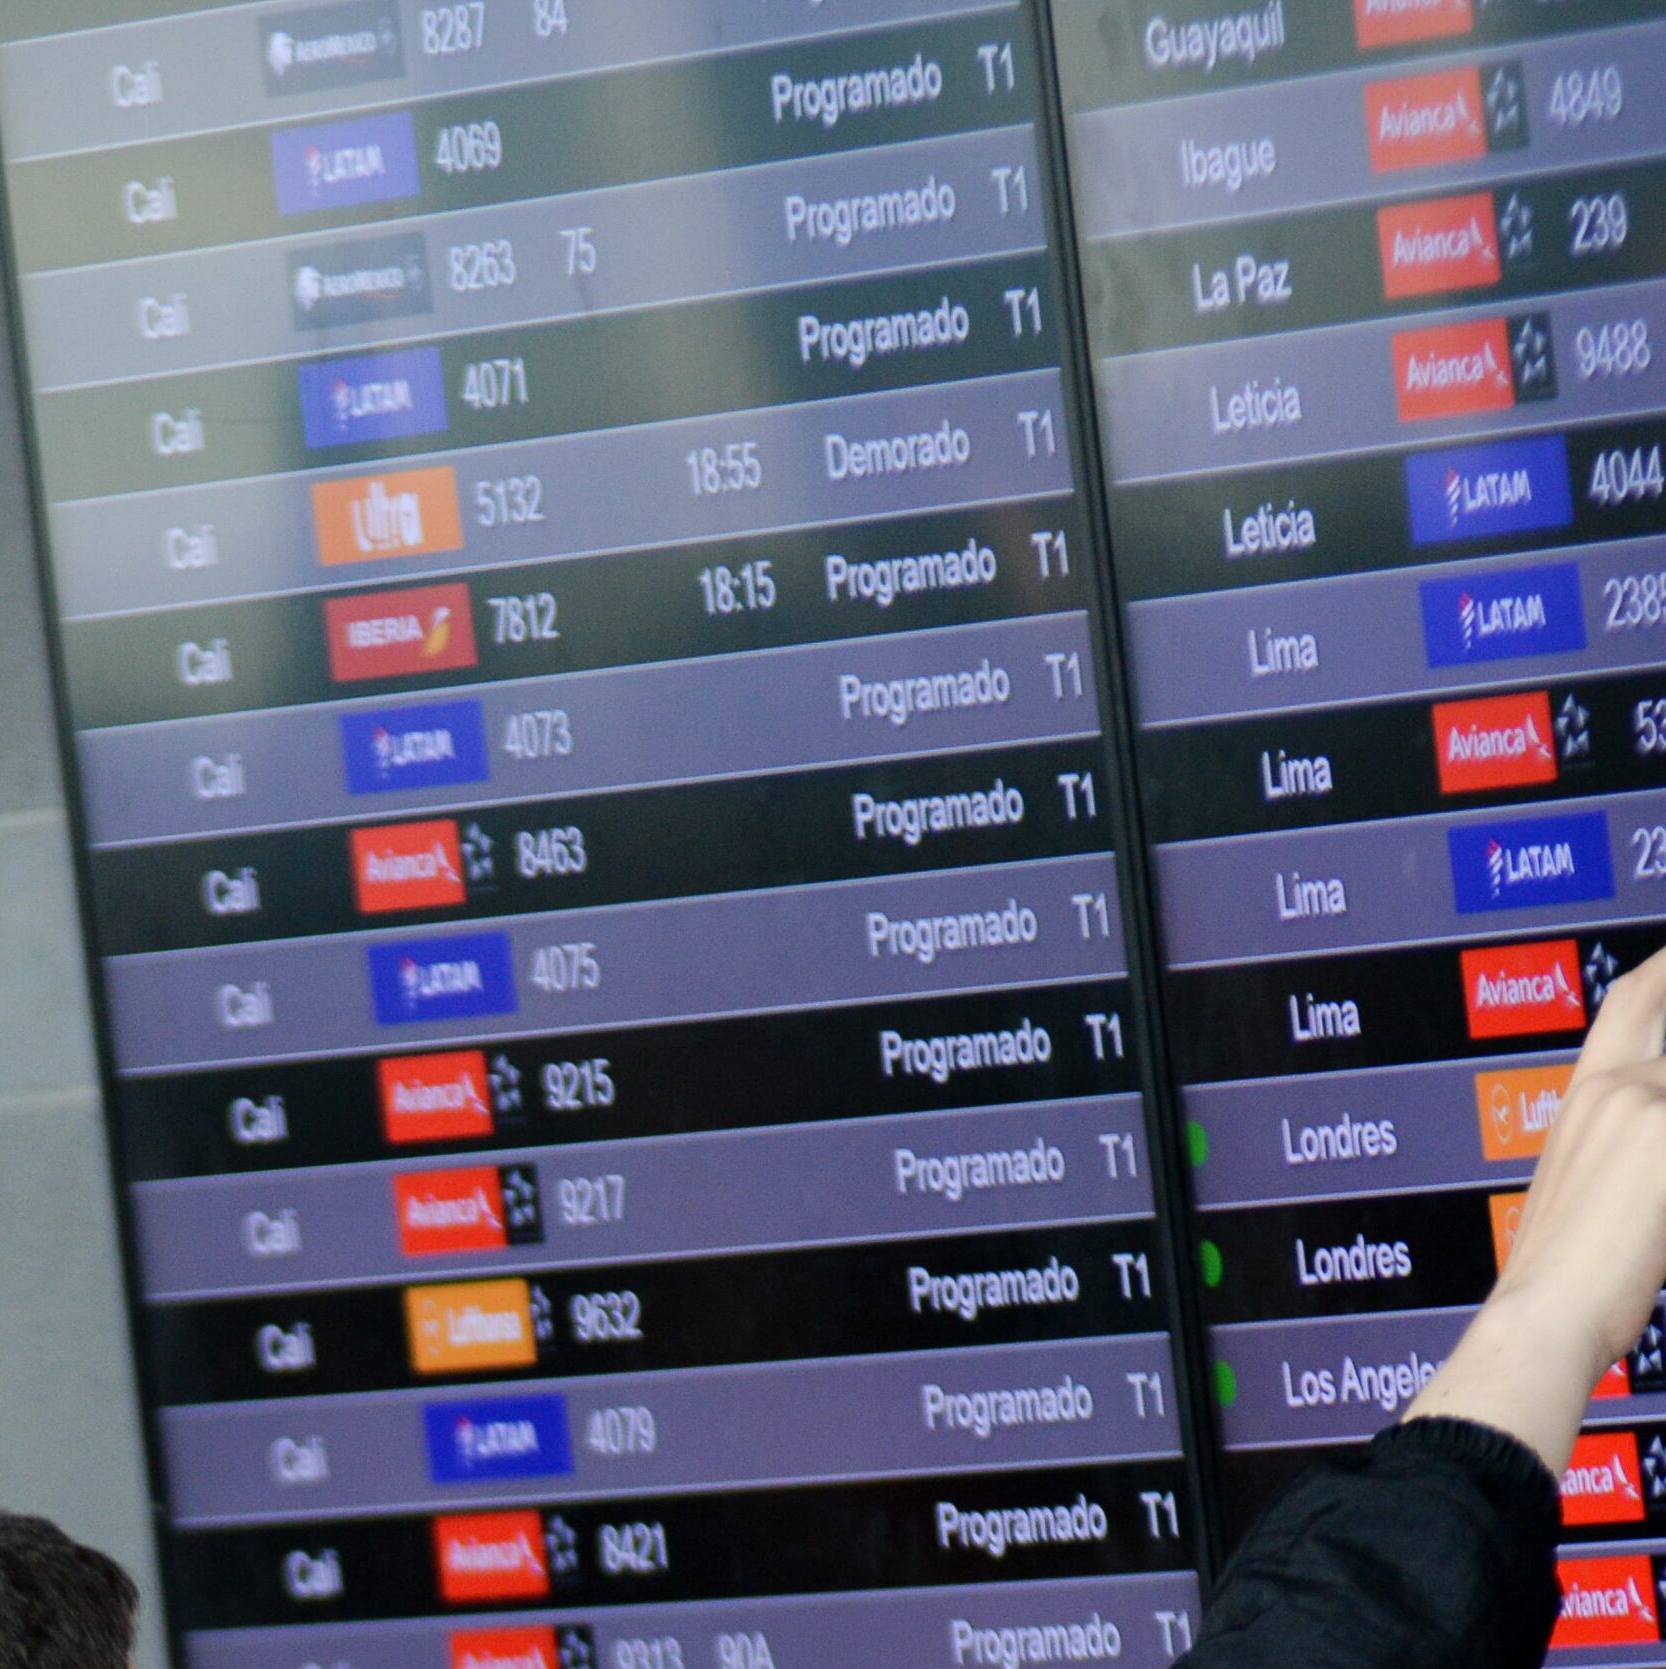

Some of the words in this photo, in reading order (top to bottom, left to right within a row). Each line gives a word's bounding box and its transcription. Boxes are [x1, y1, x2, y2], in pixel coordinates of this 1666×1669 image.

[110, 62, 162, 107] Cali
[421, 1, 485, 54] 8287
[1145, 8, 1286, 73] Guayaquil
[124, 177, 178, 224] Cali
[435, 121, 502, 173] 4069
[771, 53, 942, 127] Programado
[977, 42, 1015, 94] T1
[1180, 137, 1276, 190] Ibague
[1379, 91, 1456, 140] Avianca
[1549, 66, 1623, 127] 4849
[138, 293, 191, 340] Cali
[449, 240, 516, 292] 8263
[561, 227, 596, 275] 75
[785, 177, 956, 245] Programado
[991, 165, 1028, 213] T1
[1192, 262, 1229, 312] La
[1237, 255, 1293, 302] Paz
[1392, 228, 1470, 265] Avianca
[1570, 194, 1628, 257] 239
[152, 410, 205, 455] Cali
[463, 357, 529, 409] 4071
[799, 296, 969, 367] Programado
[1005, 287, 1042, 338] T1
[1210, 379, 1302, 432] Leticia
[1406, 350, 1484, 389] Avianca
[1576, 321, 1651, 380] 9488
[166, 525, 217, 570] Cali
[475, 476, 545, 527] 5132
[686, 442, 763, 495] 18:55
[824, 420, 970, 480] Demorado
[1018, 409, 1056, 456] T1
[1223, 501, 1316, 559] Leticia
[1463, 468, 1531, 510] LATAM
[1589, 445, 1665, 501] 4044
[177, 638, 232, 685] Cali
[347, 616, 422, 648] IBERIA
[488, 592, 559, 644] 7812
[699, 560, 776, 615] 18:15
[825, 538, 996, 606] Programado
[1032, 531, 1070, 578] T1
[1248, 627, 1319, 678] Lima
[1476, 592, 1546, 637] LATAM
[192, 754, 245, 799] Cali
[503, 709, 572, 761] 4073
[840, 659, 1010, 725] Programado
[1045, 652, 1083, 699] T1
[1261, 748, 1334, 801] Lima
[1448, 723, 1524, 765] Avianca
[203, 868, 261, 916] Cali
[514, 827, 587, 879] 8463
[852, 779, 1025, 845] Programado
[1057, 772, 1096, 820] T1
[1275, 872, 1347, 922] Lima
[1505, 843, 1574, 881] LATAM
[532, 942, 600, 993] 4075
[866, 898, 1037, 964] Programado
[1072, 893, 1110, 940] T1
[1289, 993, 1361, 1043] Lima
[1476, 970, 1553, 1011] Avianca
[541, 1058, 615, 1112] 9215
[879, 1018, 1051, 1085] Programado
[1084, 1012, 1124, 1060] T1
[557, 1174, 625, 1227] 9217
[893, 1137, 1065, 1201] Programado
[1099, 1133, 1137, 1179] T1
[1283, 1113, 1396, 1164] Londres
[569, 1290, 643, 1342] 9632
[907, 1256, 1079, 1322] Programado
[1112, 1252, 1152, 1299] T1
[1295, 1234, 1412, 1287] Londres
[588, 1405, 656, 1455] 4079
[921, 1375, 1093, 1439] Programado
[1127, 1371, 1165, 1419] T1
[1283, 1360, 1335, 1409] Los
[597, 1522, 668, 1575] 8421
[935, 1493, 1107, 1559] Programado
[1140, 1491, 1179, 1538] T1
[1155, 1610, 1192, 1657] T1
